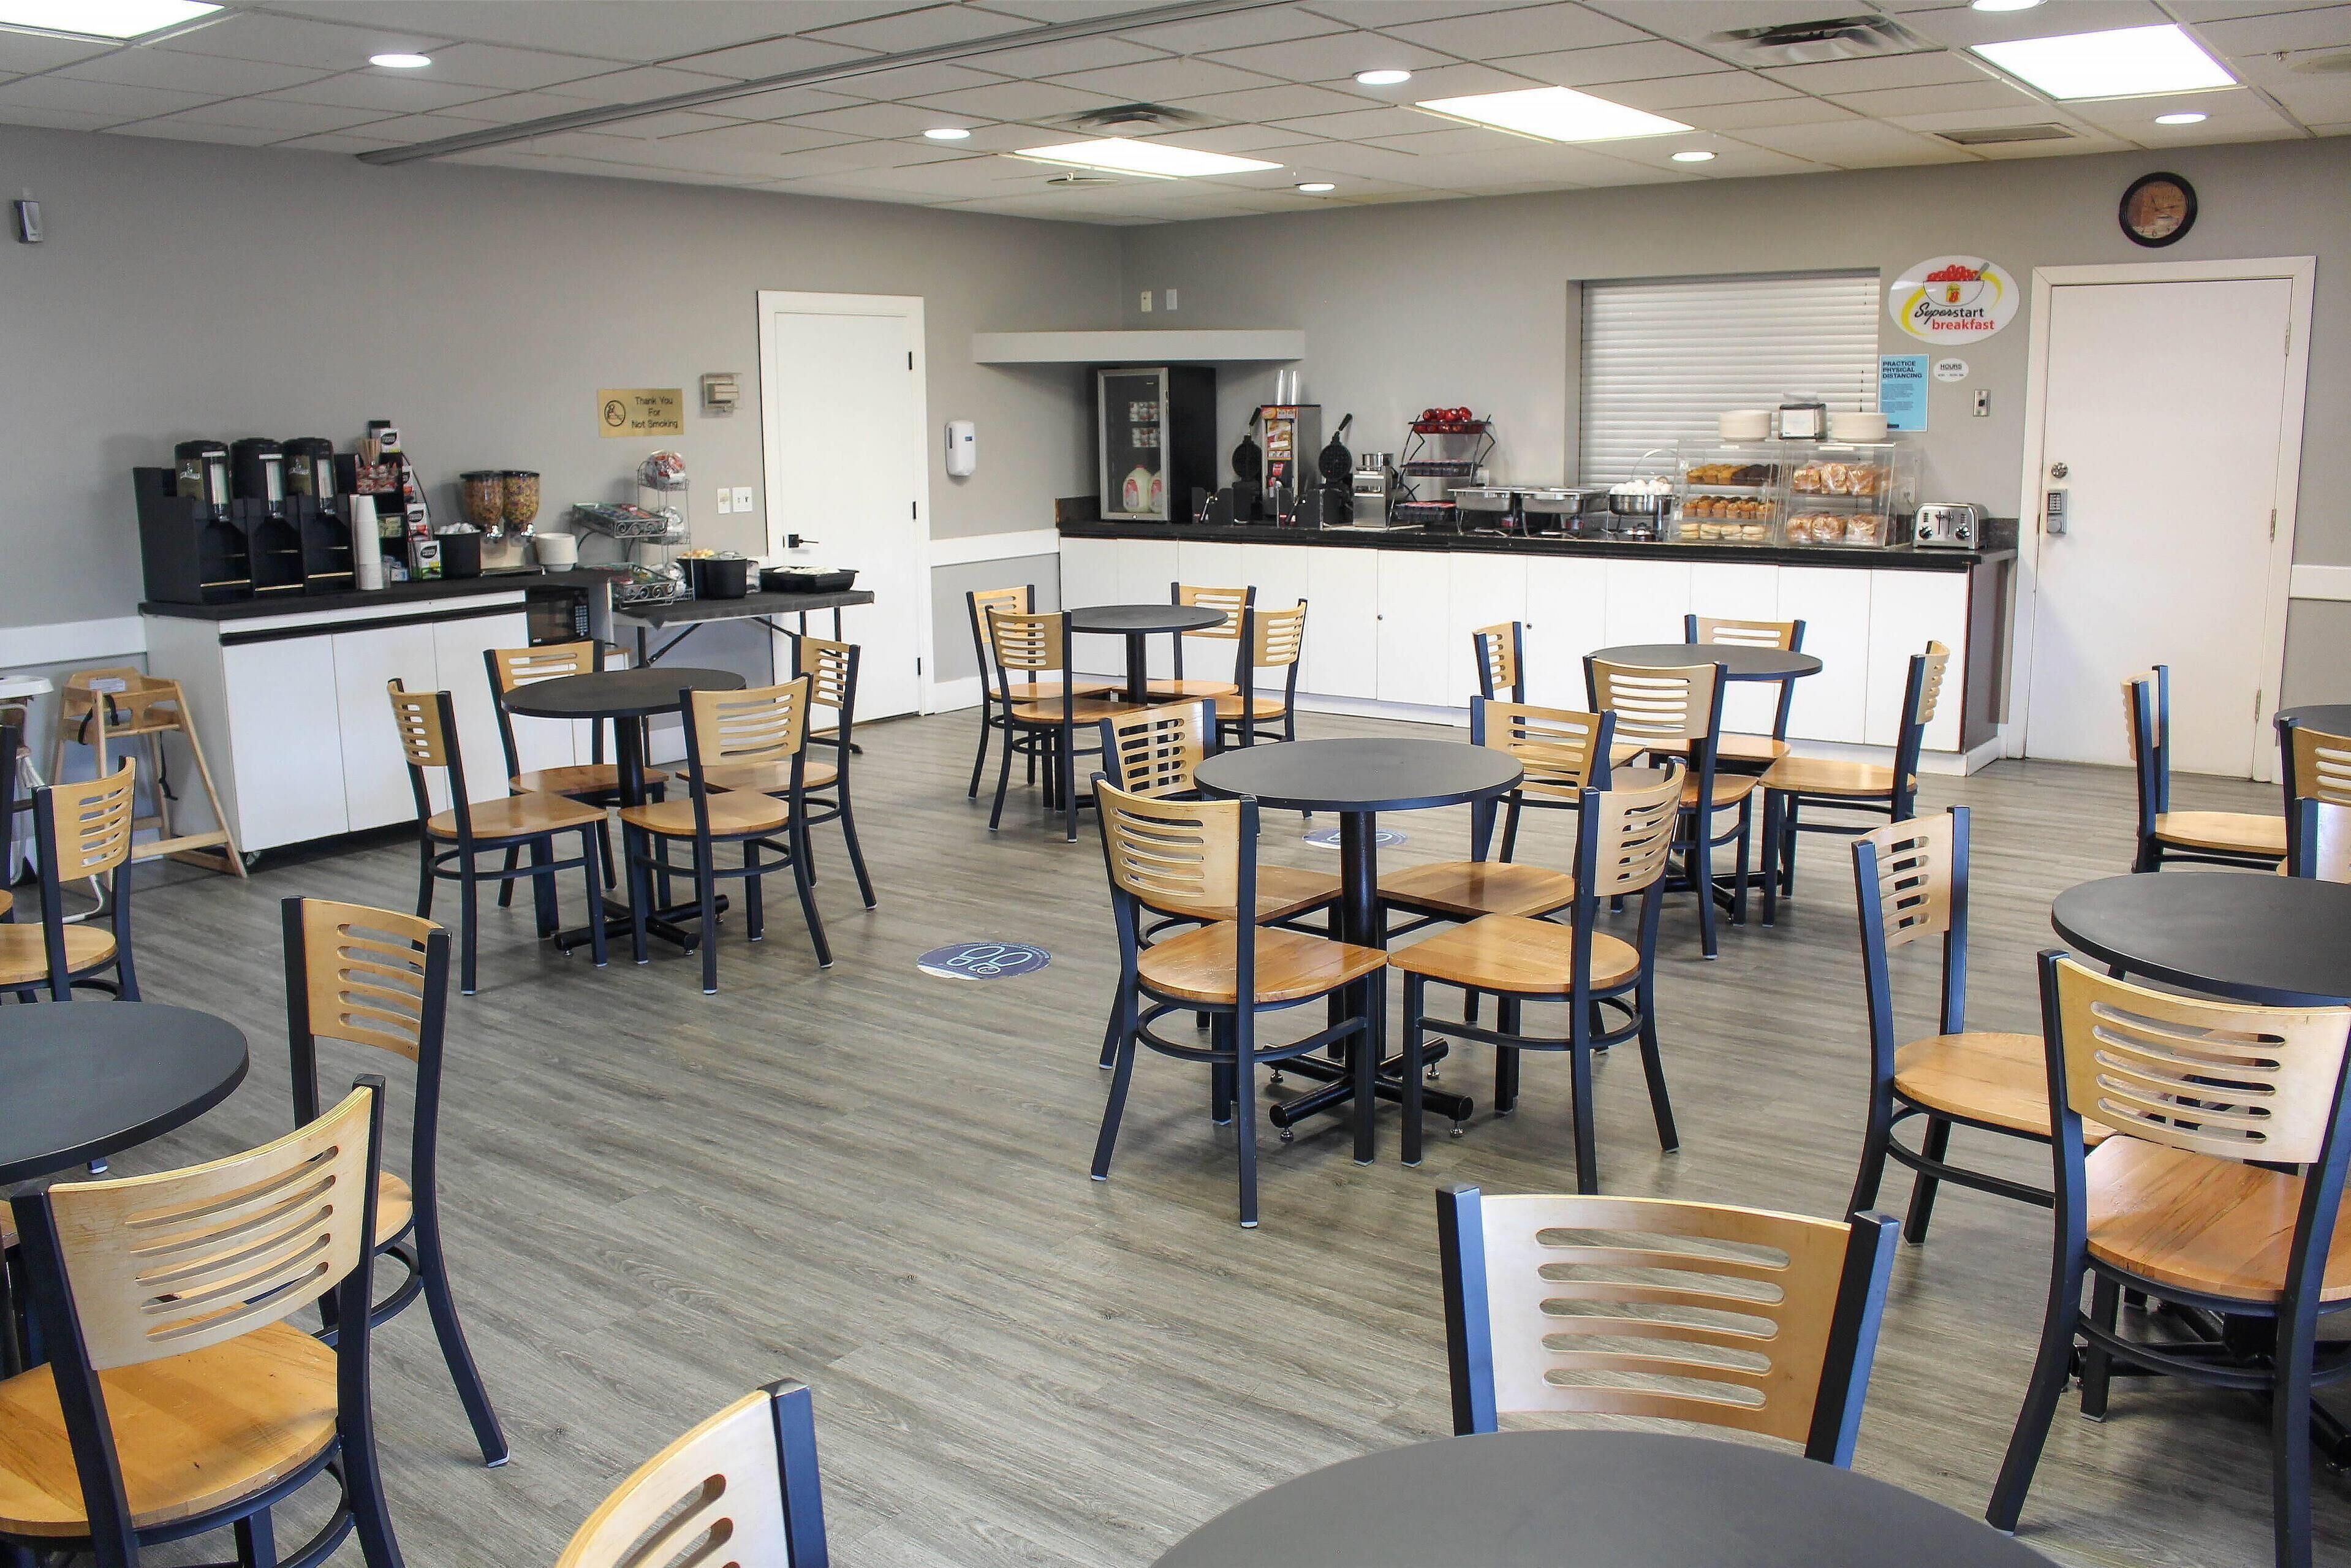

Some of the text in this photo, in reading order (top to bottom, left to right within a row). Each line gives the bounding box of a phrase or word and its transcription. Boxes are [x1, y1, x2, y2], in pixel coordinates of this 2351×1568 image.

[1914, 302, 1985, 325] Superstart
[1932, 319, 1994, 330] breakfast
[635, 396, 657, 405] Thank
[631, 420, 678, 428] Not Smoking
